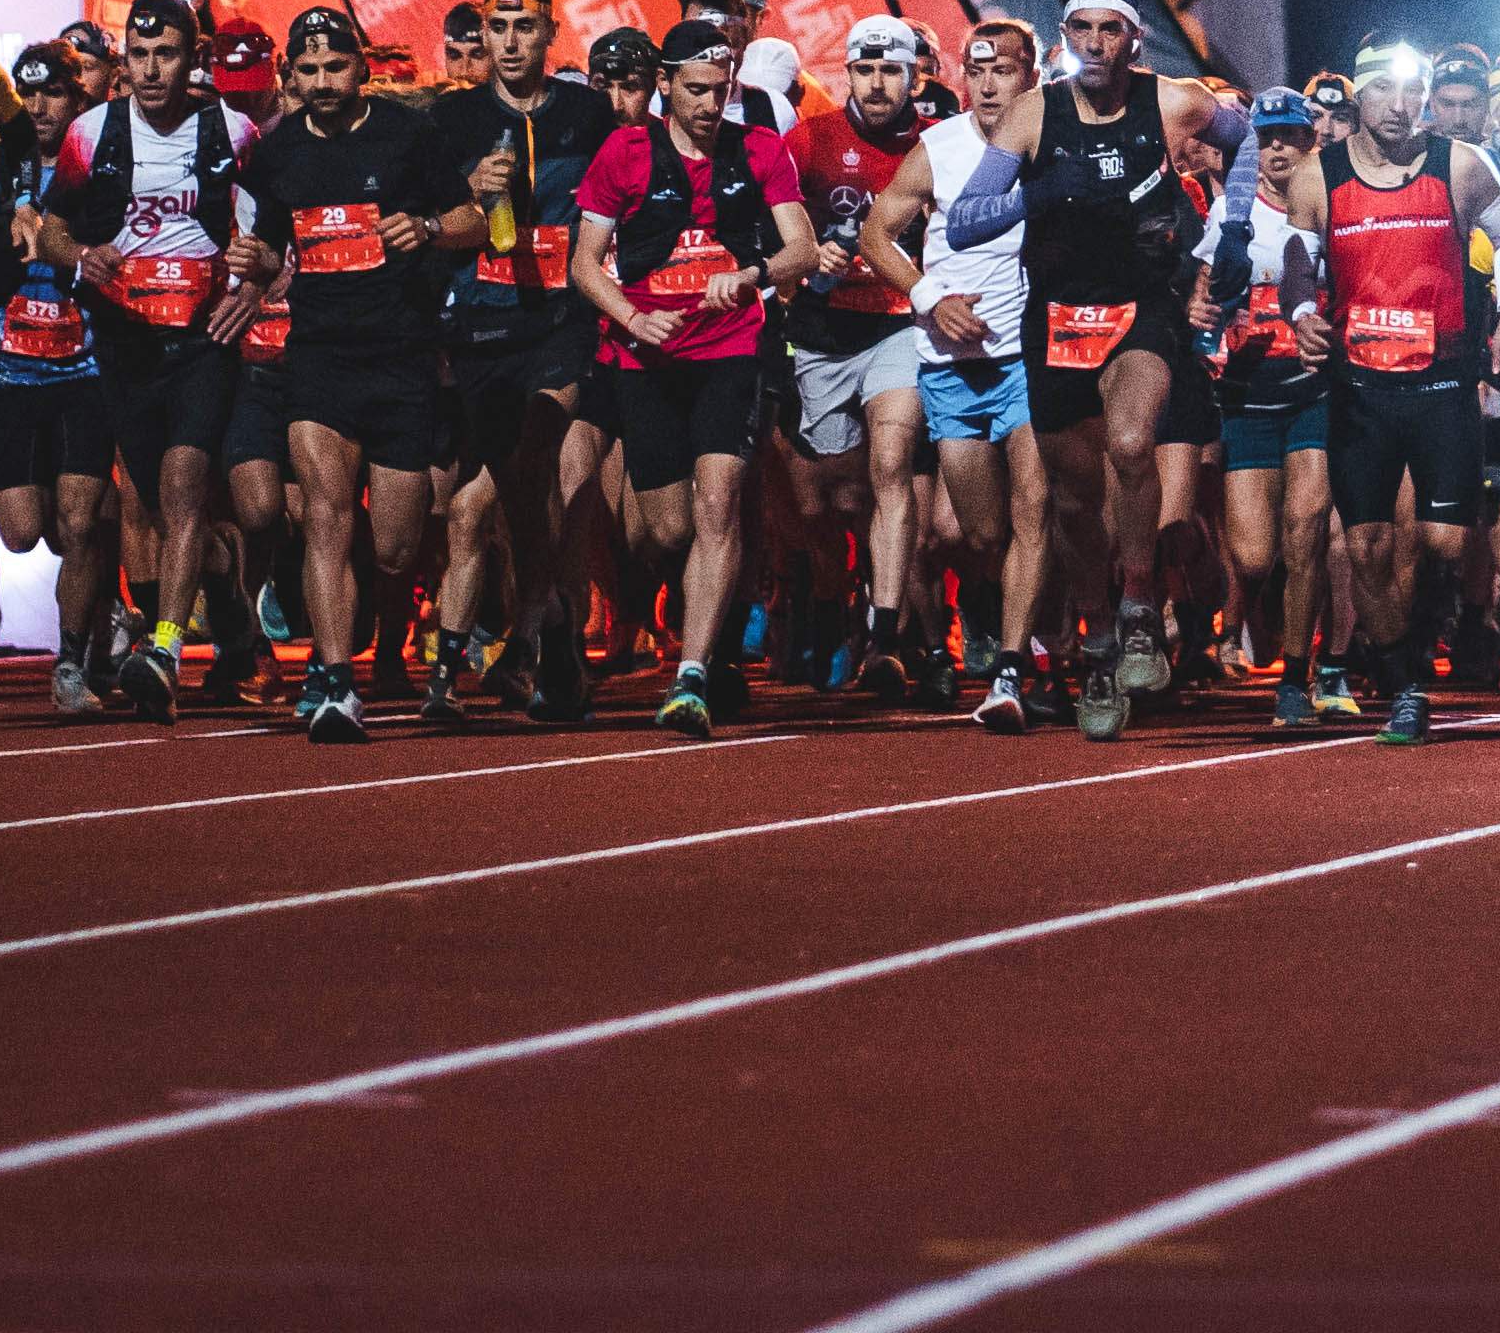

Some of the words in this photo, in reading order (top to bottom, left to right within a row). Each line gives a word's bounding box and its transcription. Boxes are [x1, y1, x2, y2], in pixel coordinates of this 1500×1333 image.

[322, 207, 347, 225] 29
[680, 229, 705, 247] 17
[156, 261, 183, 279] 25
[26, 301, 60, 318] 578
[1073, 306, 1108, 322] 757
[1367, 308, 1416, 328] 1156
